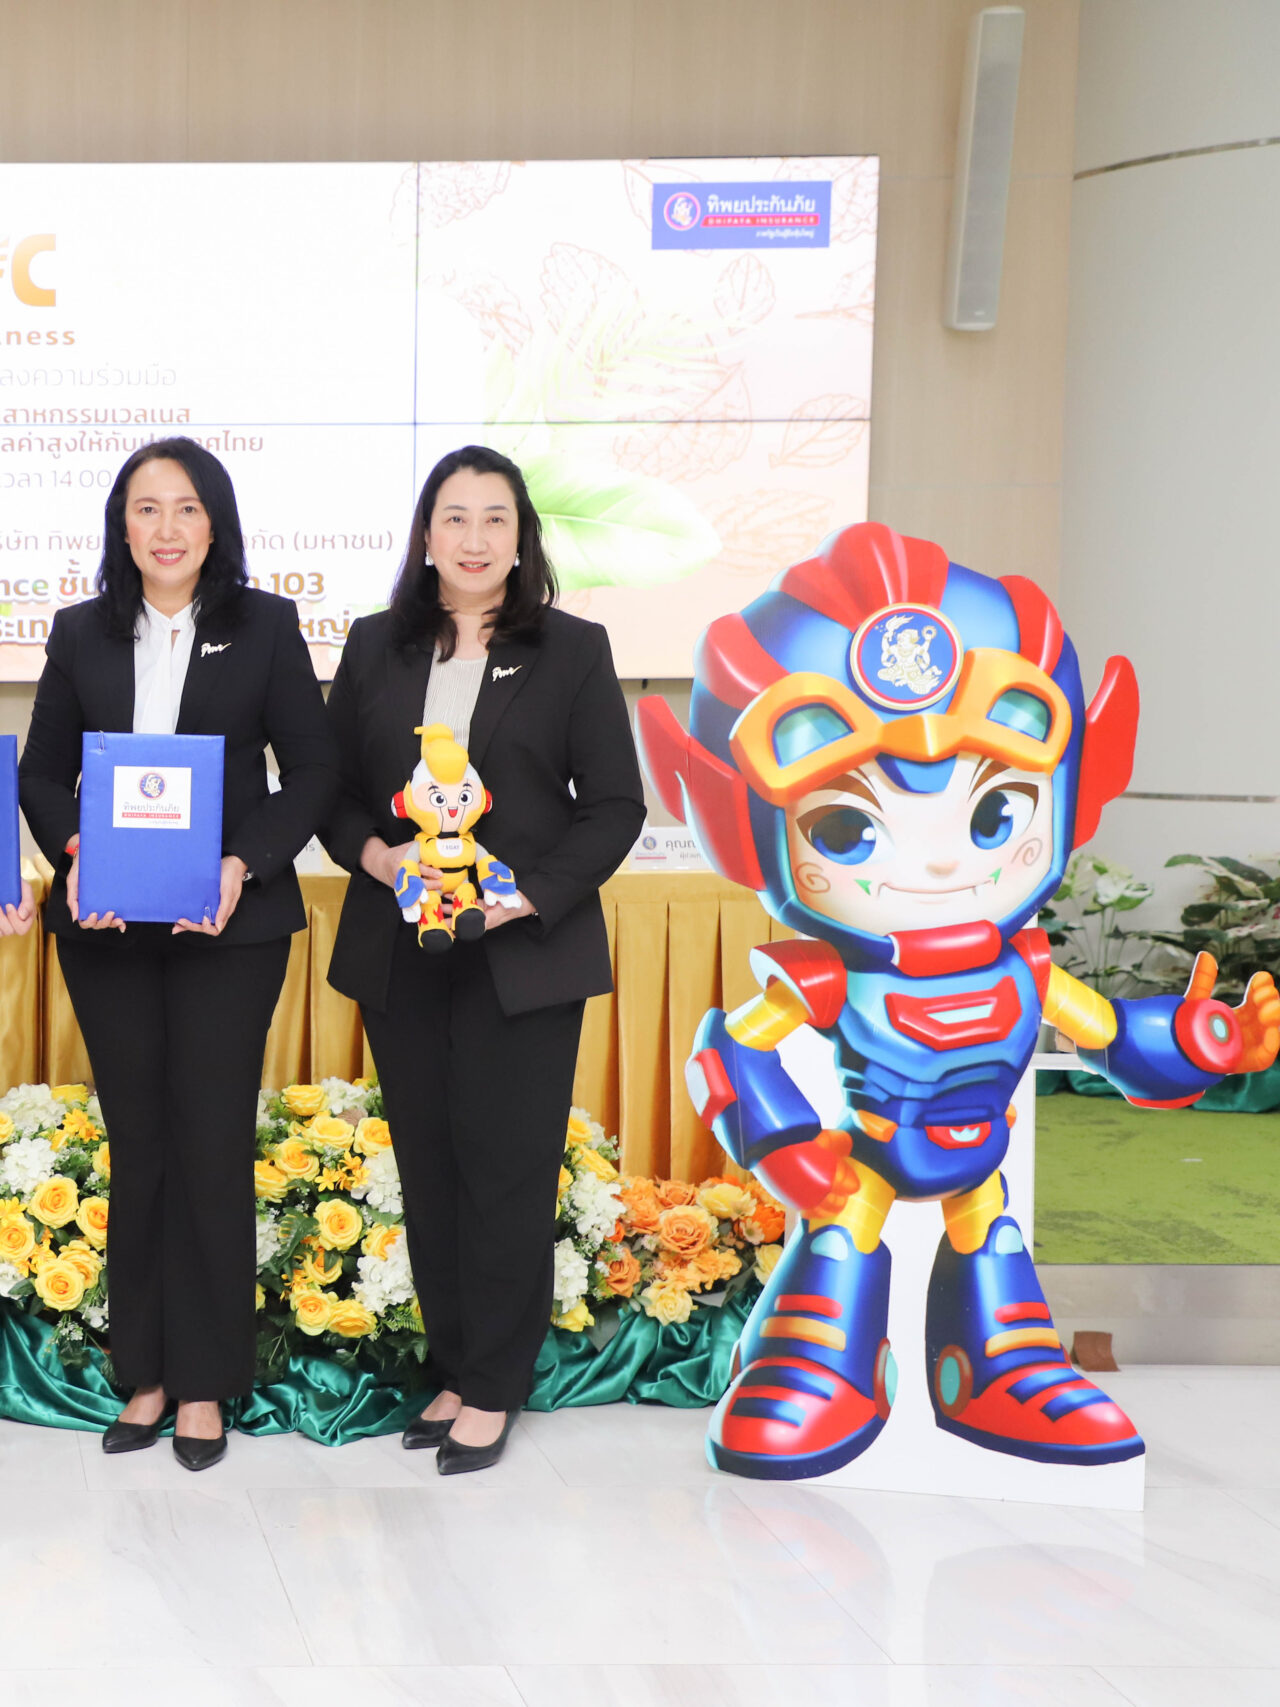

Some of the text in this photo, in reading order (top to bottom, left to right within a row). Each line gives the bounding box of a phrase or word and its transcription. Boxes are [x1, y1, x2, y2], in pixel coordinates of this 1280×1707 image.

[706, 194, 816, 213] ทิพยประกันภัย
[293, 530, 394, 552] (มหาชน)
